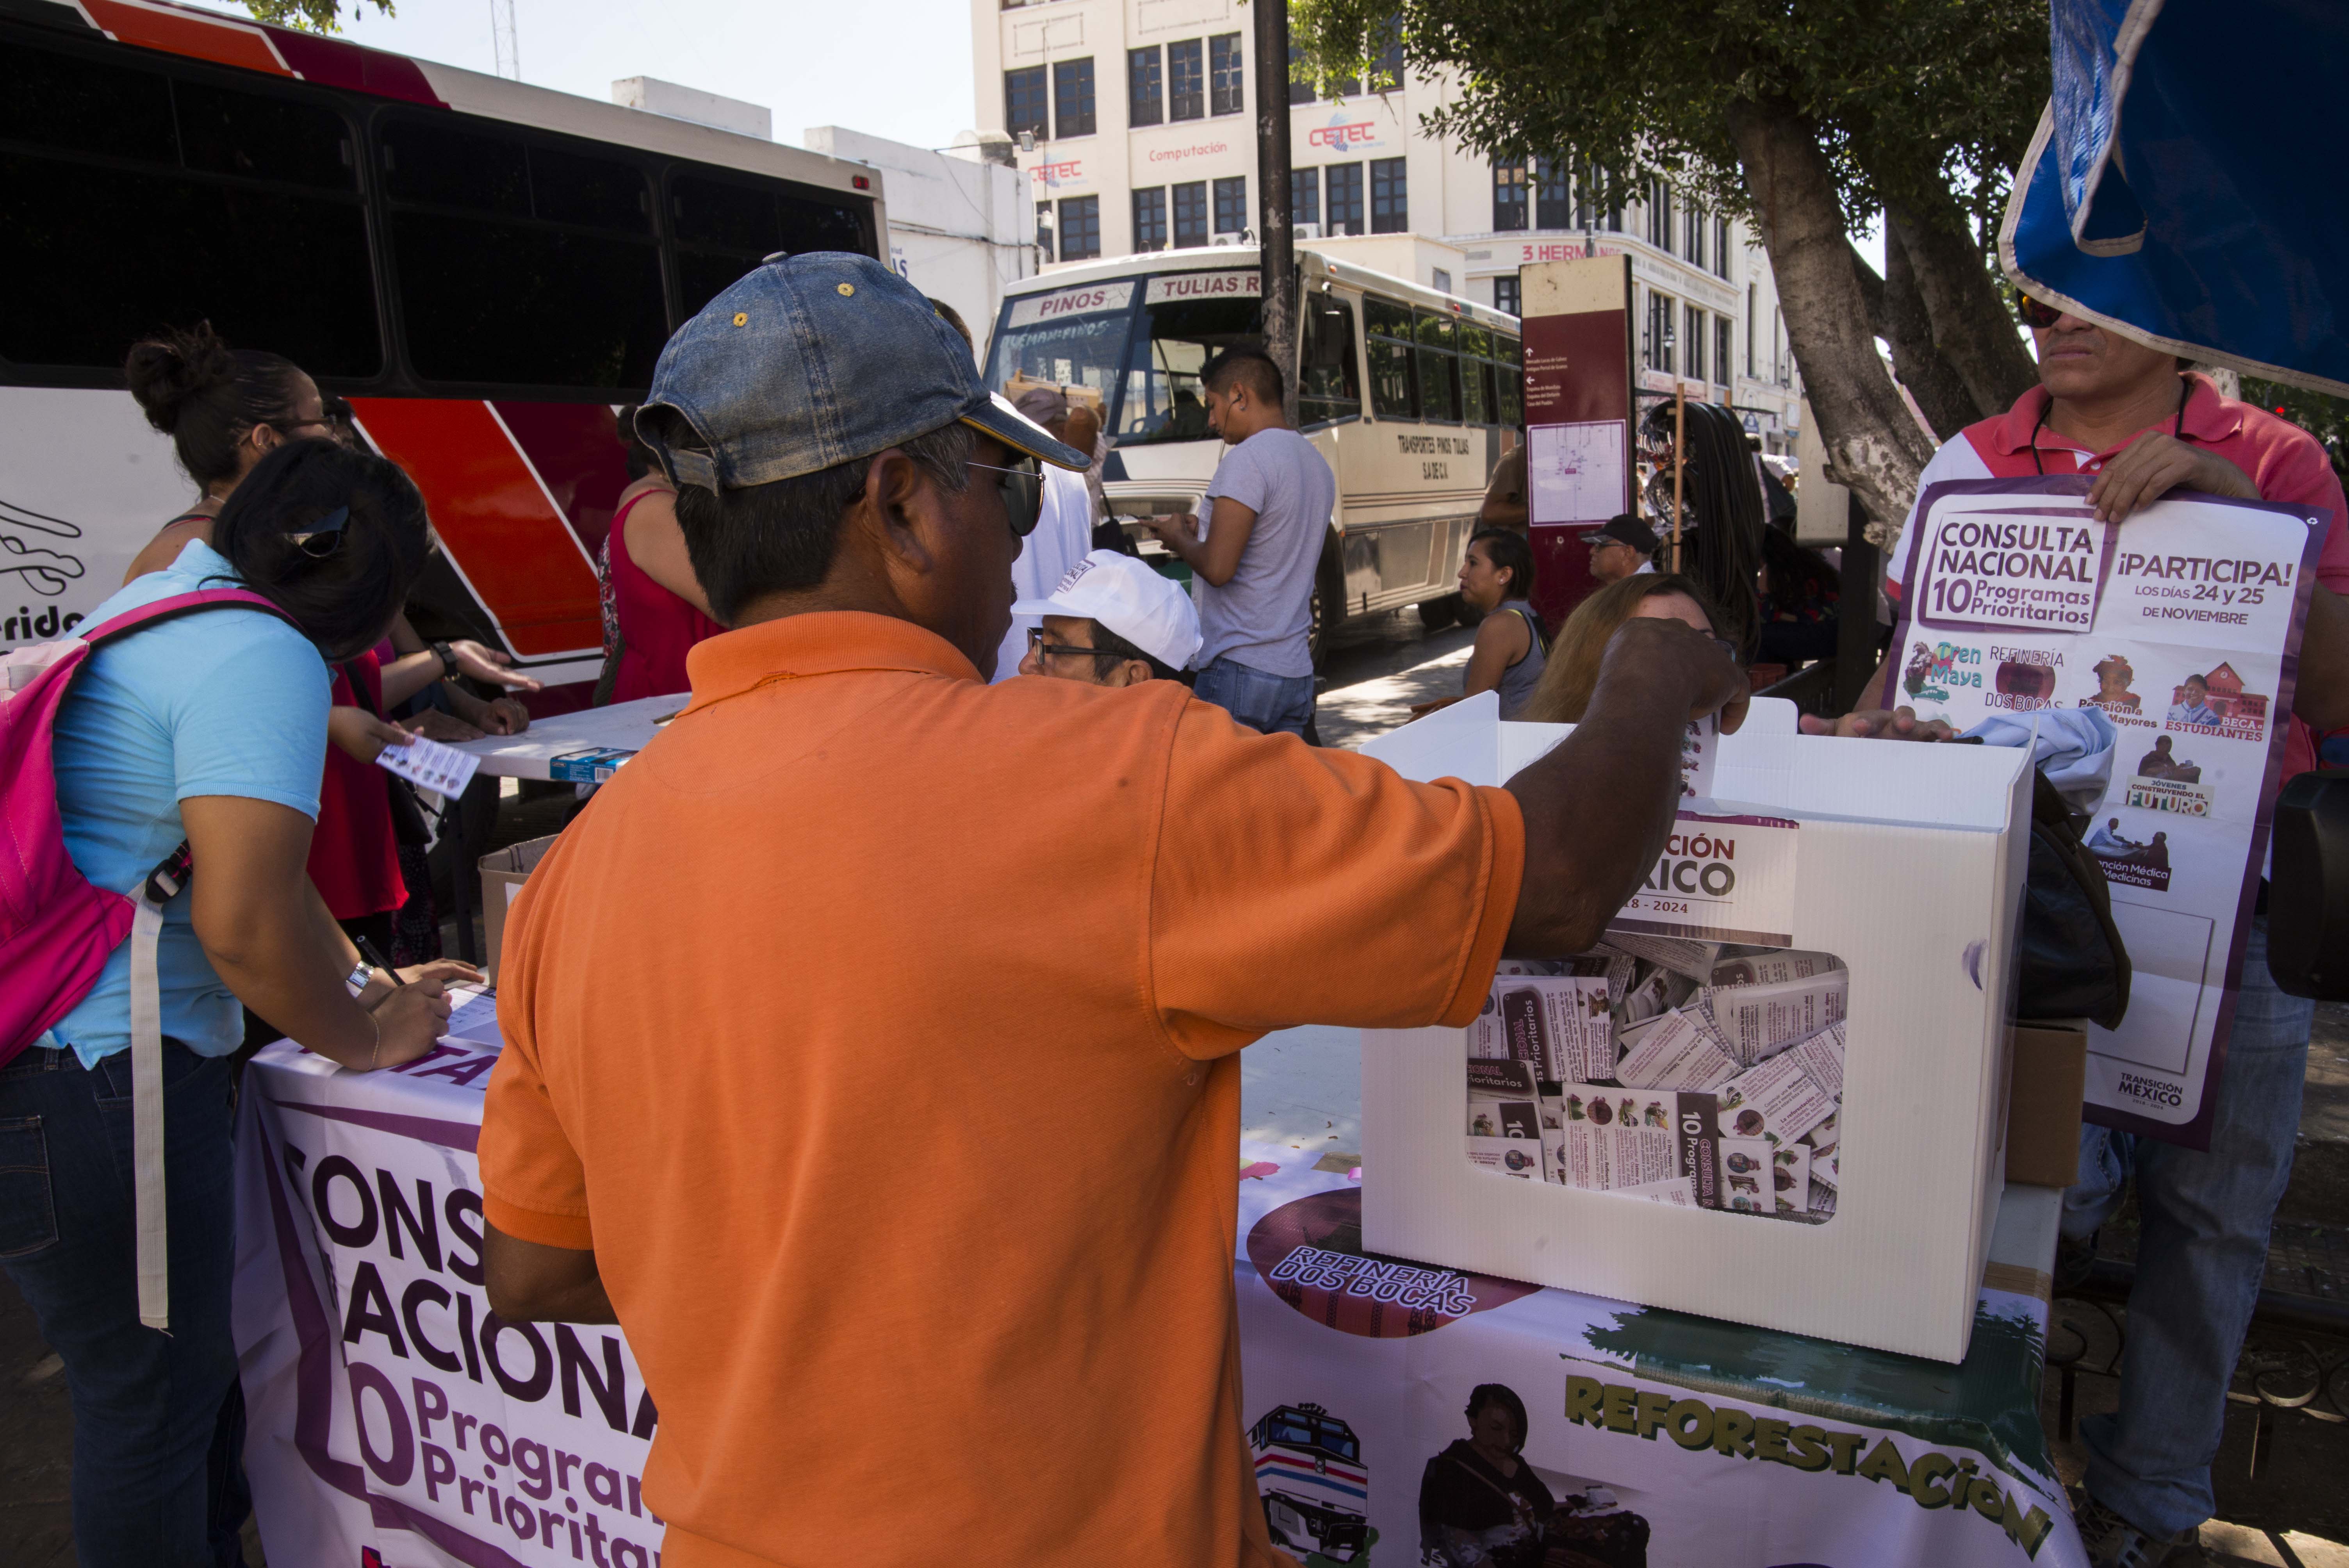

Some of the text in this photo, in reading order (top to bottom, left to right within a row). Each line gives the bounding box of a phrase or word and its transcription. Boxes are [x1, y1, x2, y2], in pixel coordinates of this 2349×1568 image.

[1309, 121, 1375, 147] CETEC
[1149, 141, 1227, 162] Computación
[1523, 245, 1533, 261] 3
[1040, 291, 1105, 316] PINOS
[1164, 277, 1238, 296] TULIAS
[1940, 522, 2094, 554] CONSULTA
[1938, 551, 2093, 583] NACIONAL
[2117, 553, 2294, 587] ¡PARTICIPA!
[1934, 578, 2091, 614] 10 Programas
[2135, 585, 2264, 606] LOS DÍAS 24 y 25
[1971, 599, 2090, 625] Prioritarios
[2142, 607, 2249, 625] DE NOVIEMBRE
[1937, 641, 1981, 664] Tren
[1990, 646, 2064, 667] REFINERÍA
[1931, 665, 1982, 688] Maya
[1985, 693, 2012, 709] DOS
[2135, 707, 2143, 716] a
[2165, 720, 2263, 742] ESTUDIANTES
[2220, 717, 2256, 730] BECA
[2132, 784, 2194, 798] CONSTRUYENDO
[2151, 779, 2187, 791] JÓVENES
[2126, 790, 2208, 817] FUTURO
[2103, 869, 2152, 886] Medicinas
[2130, 864, 2168, 879] Médica
[1653, 901, 1688, 913] 2024
[1524, 1000, 1543, 1068] Prioritarios
[2121, 1072, 2183, 1095] TRANSICIÓN
[1682, 1112, 1702, 1134] 10
[1700, 1139, 1713, 1196] CONSULTA
[1285, 1245, 1470, 1295] REFINERÍA
[1269, 1260, 1477, 1317] DOS BOCAS
[421, 1441, 661, 1568] Priorita
